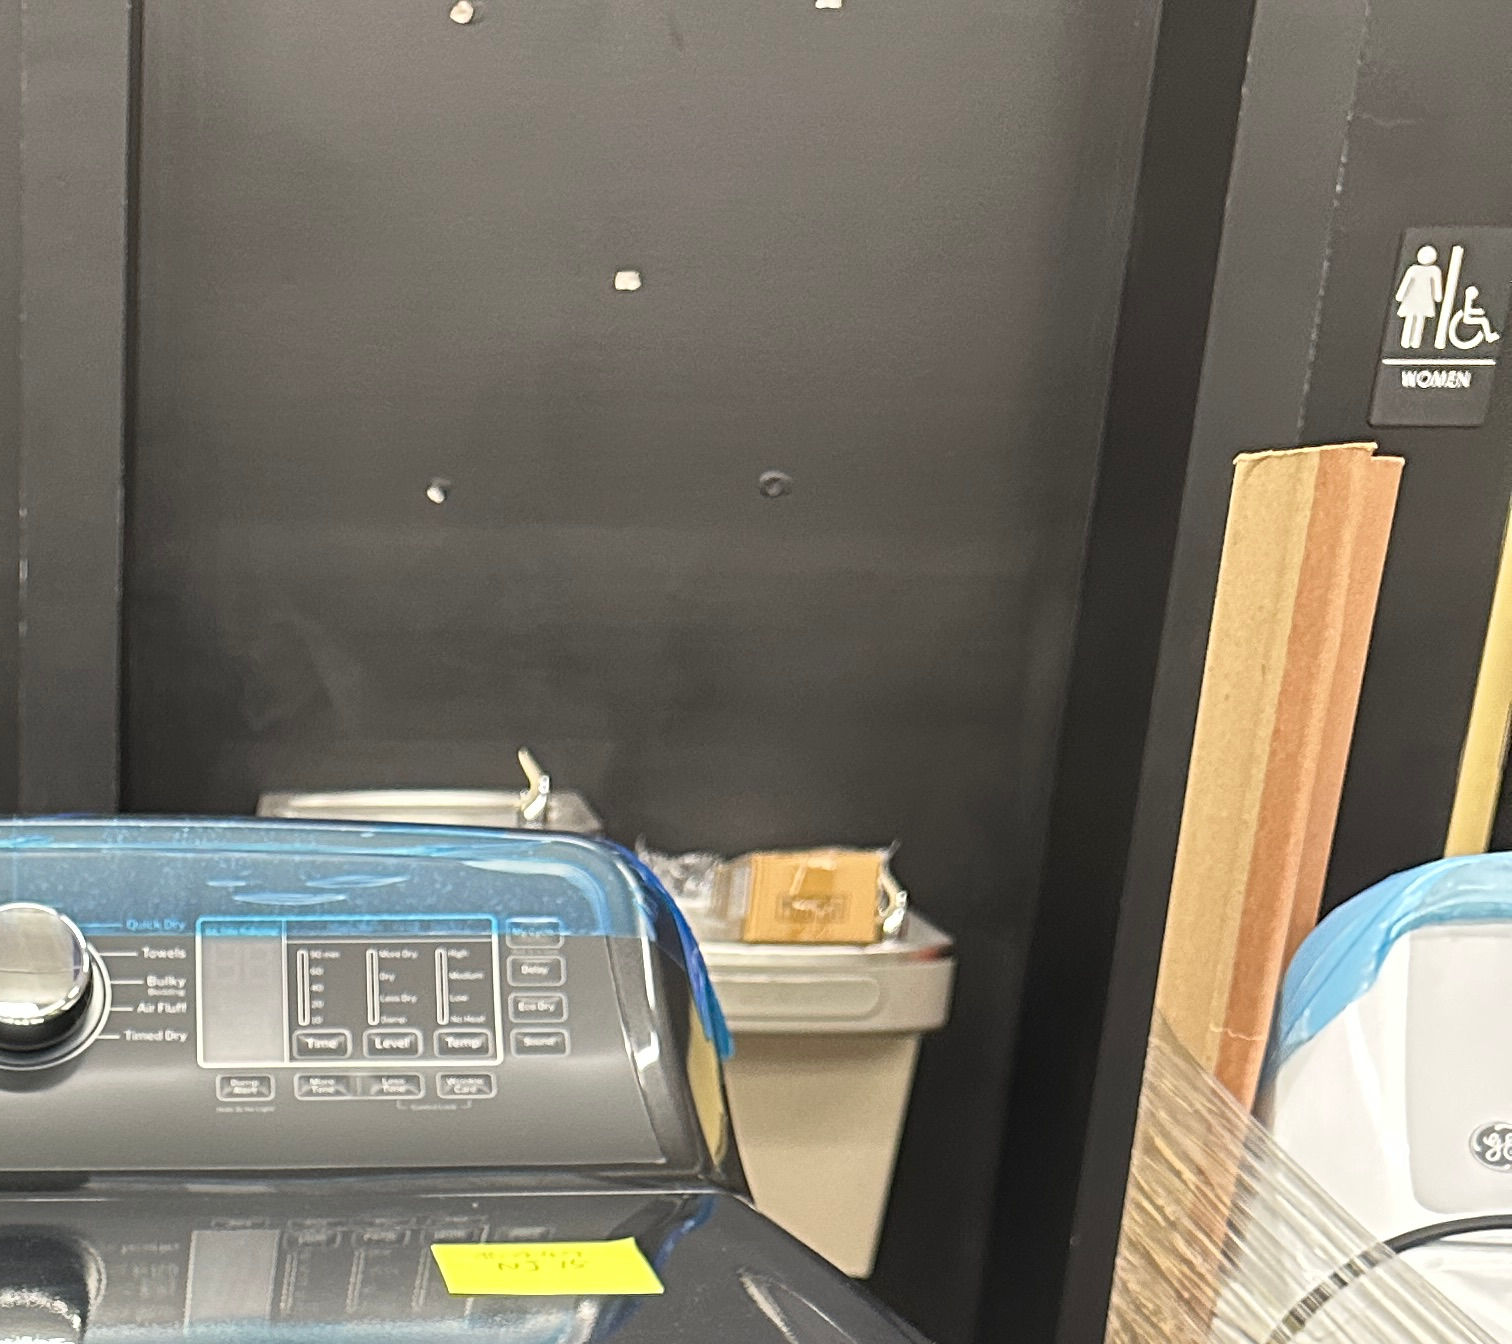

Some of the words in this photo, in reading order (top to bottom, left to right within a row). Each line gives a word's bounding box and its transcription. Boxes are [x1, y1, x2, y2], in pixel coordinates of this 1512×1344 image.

[1401, 370, 1472, 389] WOMEN
[126, 919, 160, 931] Quick
[163, 919, 186, 932] Dry
[142, 947, 187, 959] Towels
[402, 950, 419, 960] Dry
[521, 964, 550, 975] Delay
[146, 975, 187, 988] Bulky
[379, 972, 396, 983] Dry
[401, 994, 418, 1004] Dry
[137, 1002, 155, 1014] Air
[157, 1002, 187, 1014] Fluff
[518, 1001, 537, 1012] Eco
[538, 1002, 556, 1013] Dry
[124, 1030, 163, 1042] Timed
[165, 1030, 188, 1043] Dry
[306, 1038, 337, 1049] Time
[374, 1037, 411, 1050] Level
[446, 1037, 483, 1050] Temp
[310, 1077, 336, 1086] More
